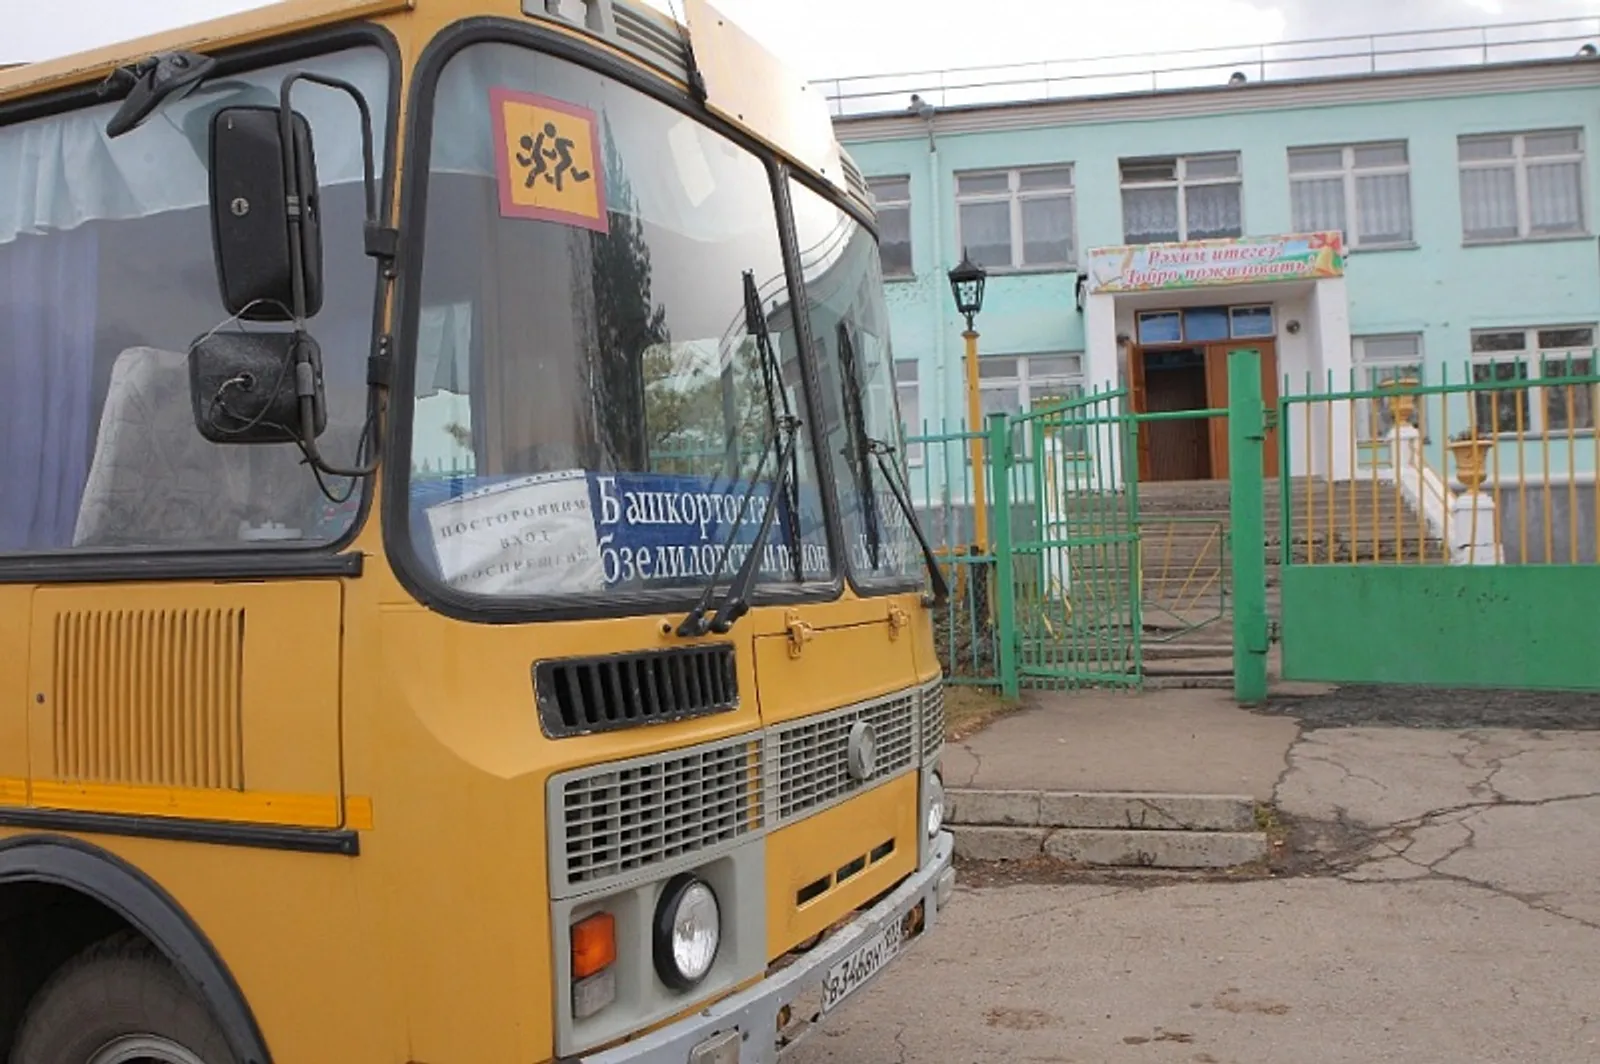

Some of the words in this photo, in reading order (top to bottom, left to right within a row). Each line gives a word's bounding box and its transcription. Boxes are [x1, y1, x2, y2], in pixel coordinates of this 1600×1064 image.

[1126, 266, 1178, 287] Добро
[1185, 255, 1316, 280] пожаловать!
[440, 499, 587, 538] ПОСТОРОННИМ
[597, 533, 777, 588] бзелиловскй
